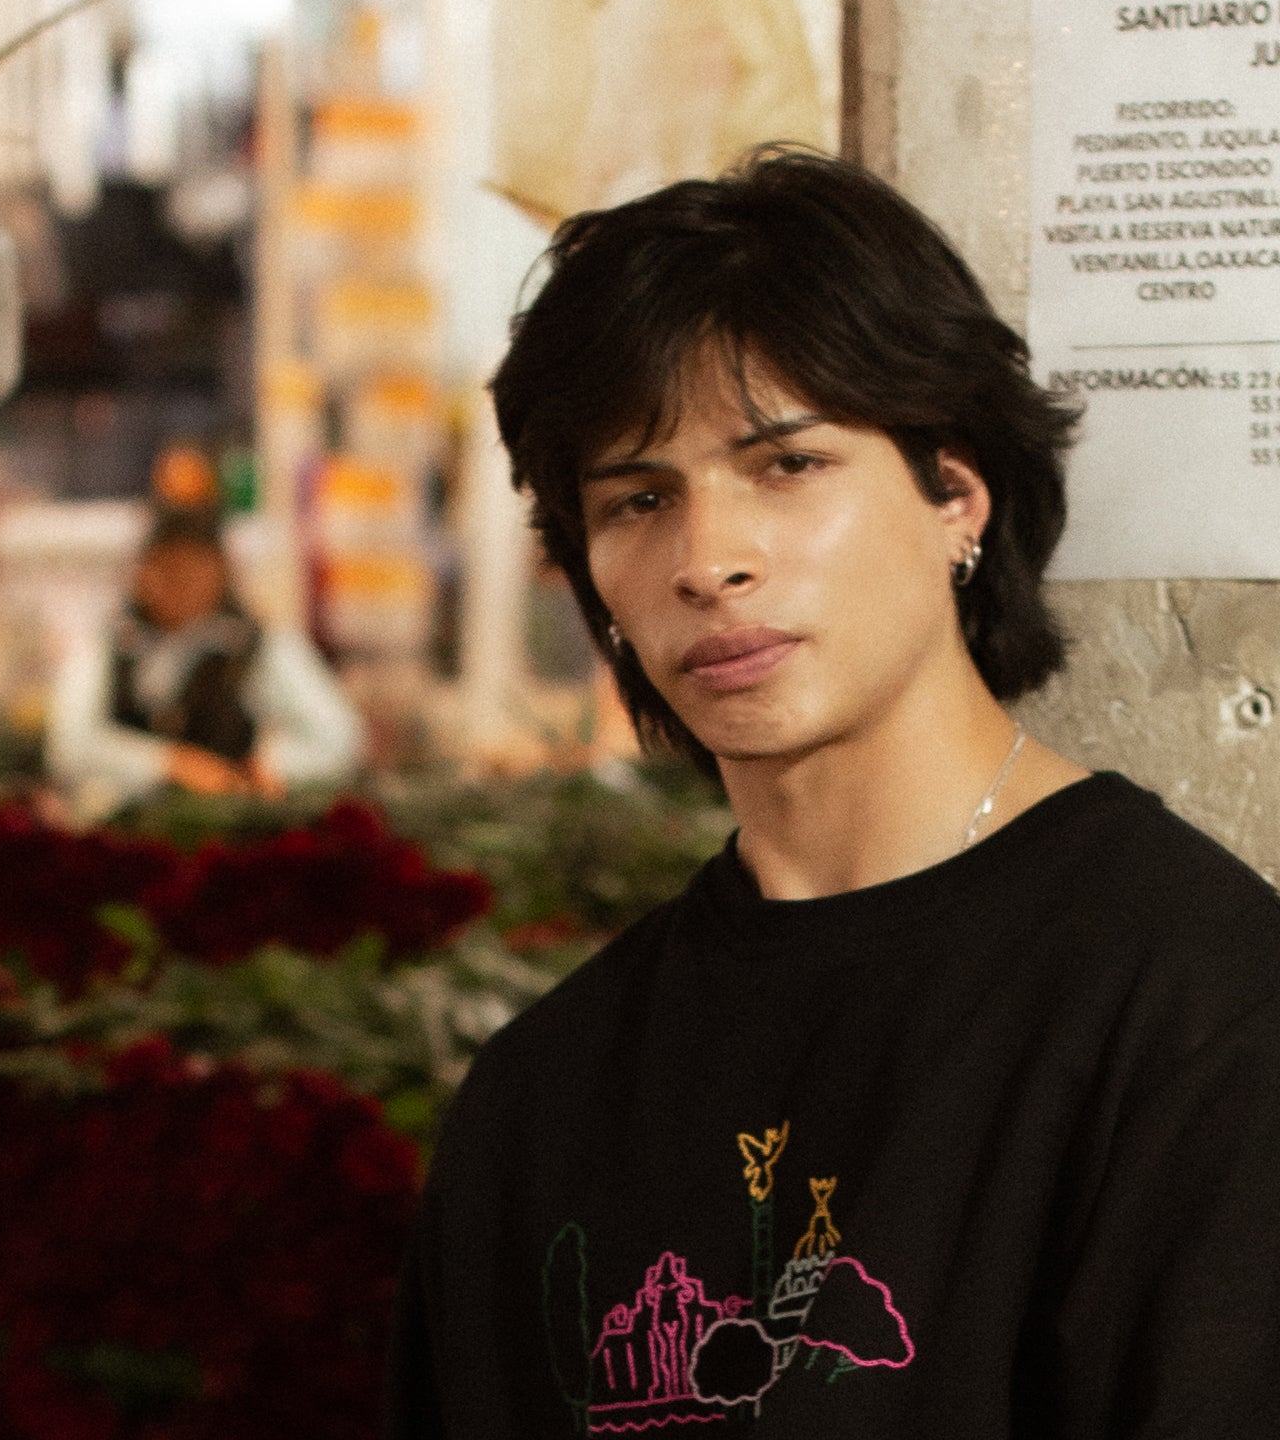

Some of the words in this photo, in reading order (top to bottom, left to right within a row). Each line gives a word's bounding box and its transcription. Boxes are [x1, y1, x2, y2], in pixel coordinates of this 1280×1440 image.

[1115, 0, 1272, 32] SANTUARIO
[1076, 162, 1151, 182] PUERTO
[1155, 158, 1273, 179] ESCONDIDO
[1056, 193, 1117, 214] PLAYA
[1122, 191, 1164, 211] SAN
[1043, 223, 1102, 245] VISITA
[1110, 222, 1123, 241] A
[1128, 220, 1215, 241] RESERVA
[1136, 280, 1217, 302] CENTRO
